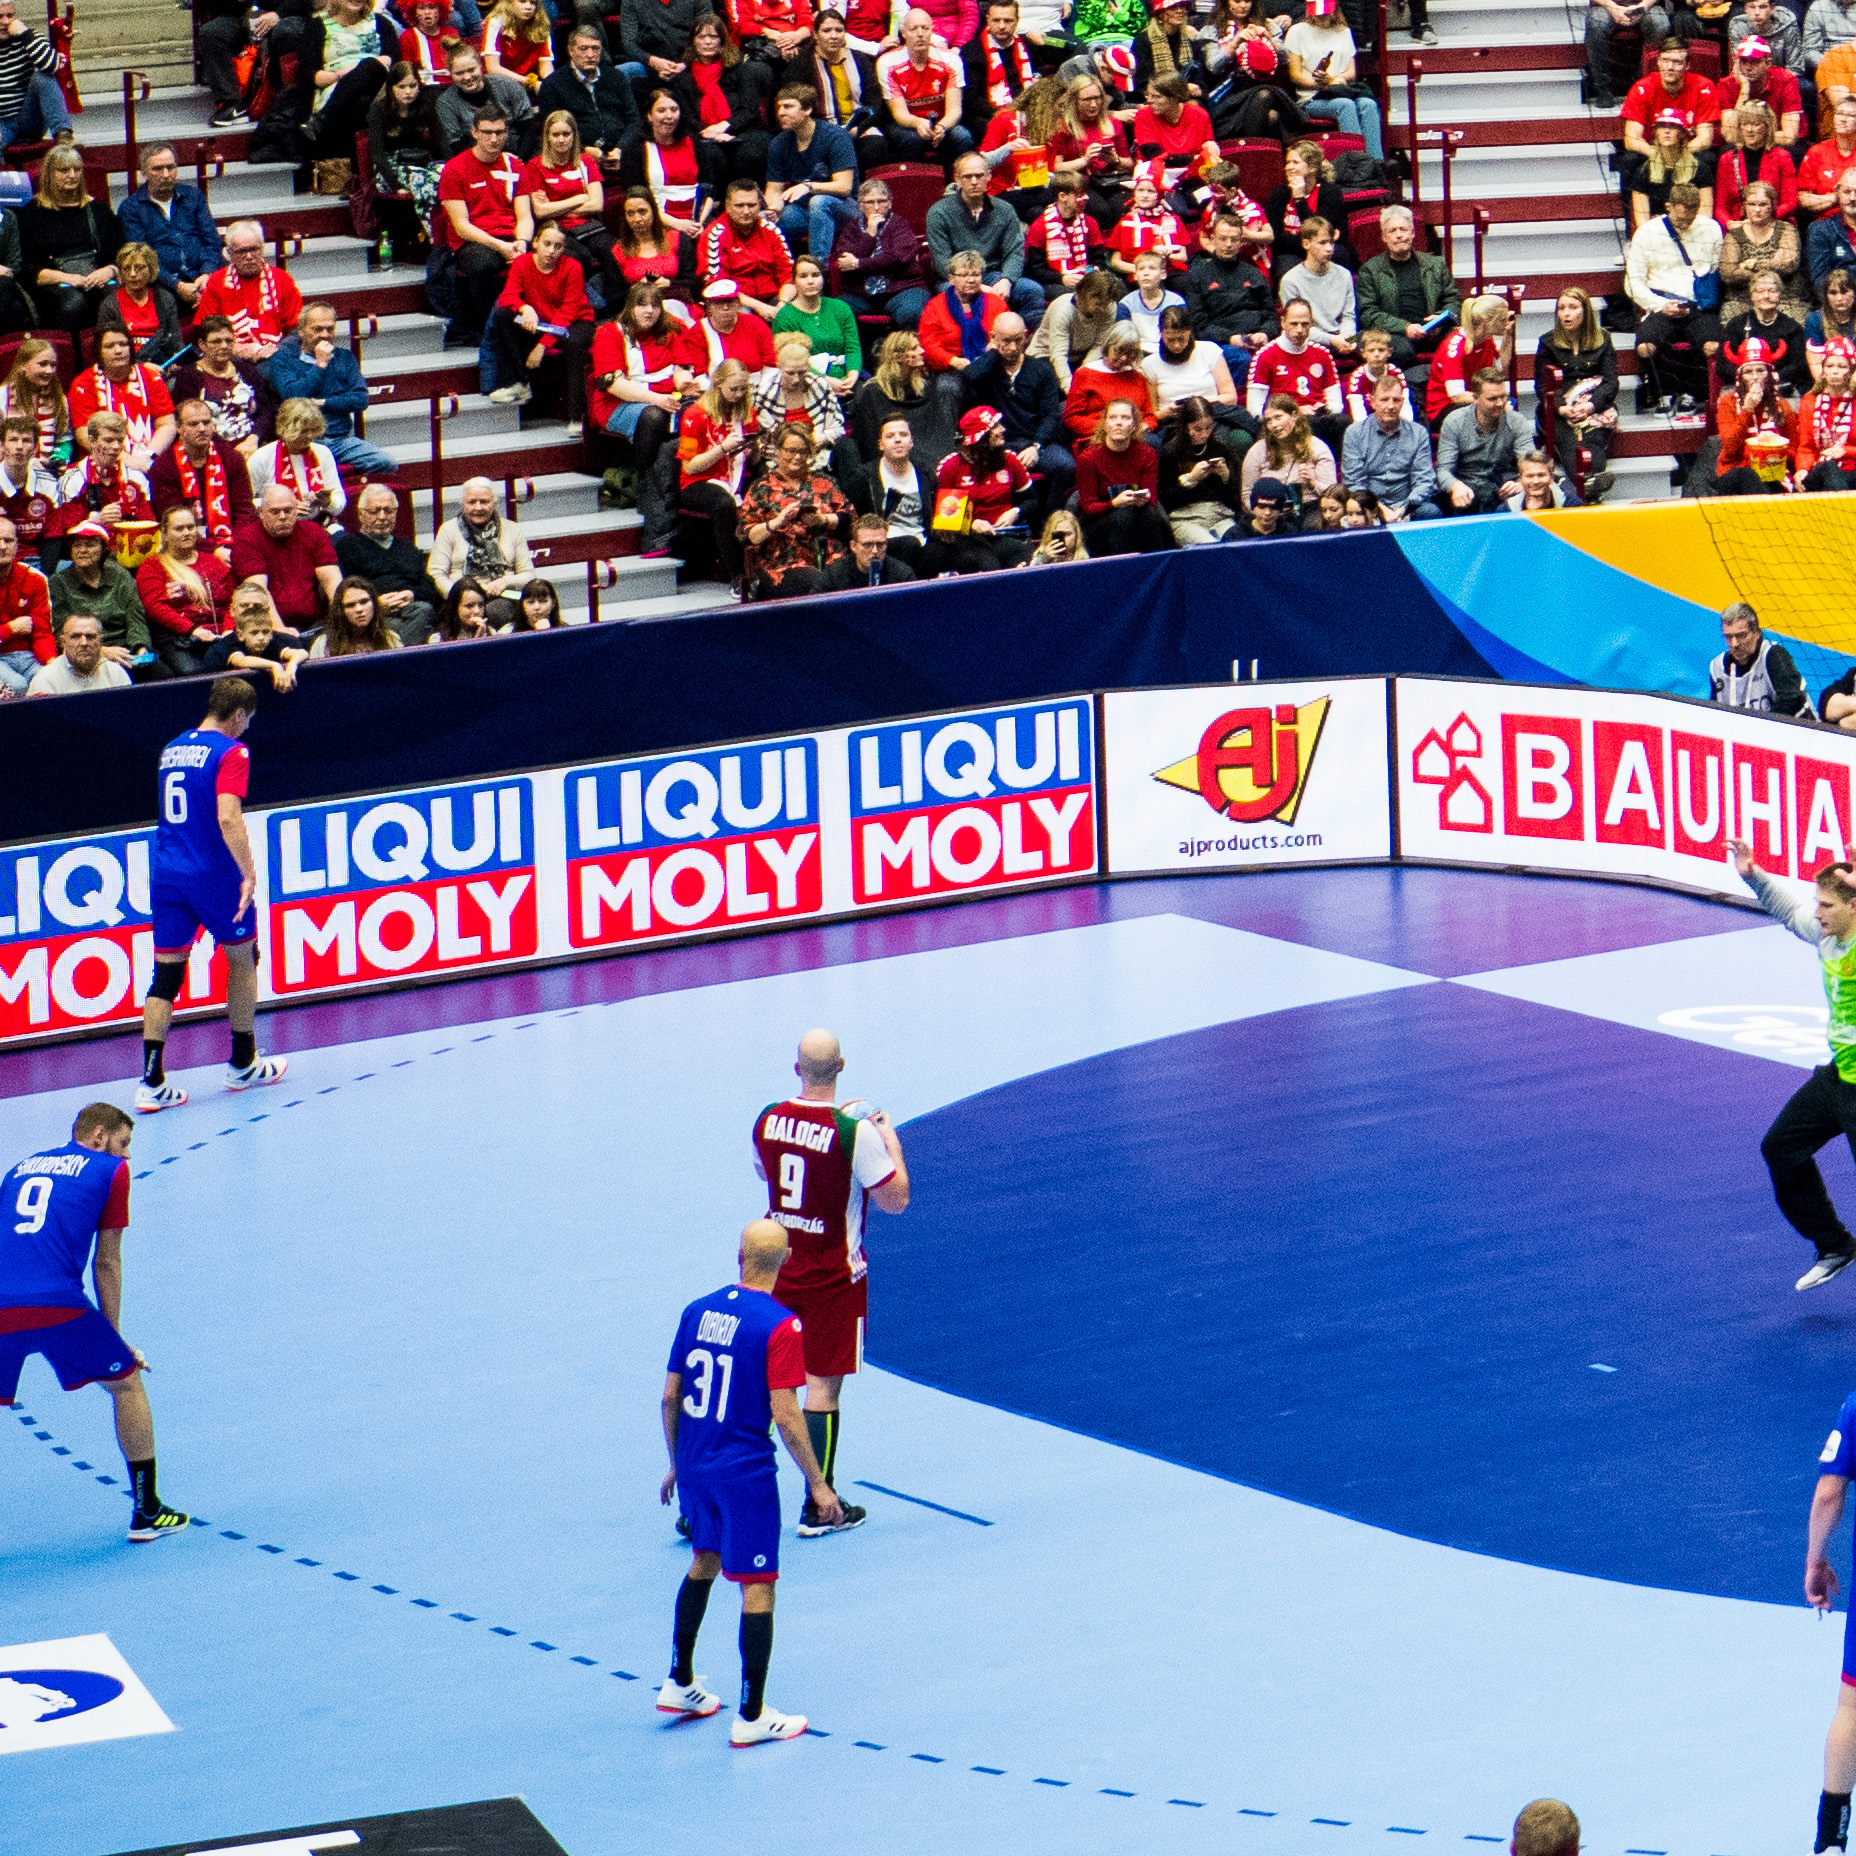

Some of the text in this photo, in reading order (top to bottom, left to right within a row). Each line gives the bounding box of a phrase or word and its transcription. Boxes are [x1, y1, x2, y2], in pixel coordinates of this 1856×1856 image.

[165, 771, 187, 824] 6
[577, 746, 809, 853] LIQUI
[859, 707, 1080, 810] LIQUI
[281, 789, 523, 896] LIQUI
[581, 830, 817, 939] MOLY
[862, 790, 1091, 896] MOLY
[1179, 831, 1324, 855] ajproducts.com
[282, 872, 532, 986] MOLY
[764, 1115, 834, 1153] BALOGH
[14, 1177, 54, 1234] 9
[779, 1153, 805, 1210] 9
[683, 1348, 733, 1423] 31
